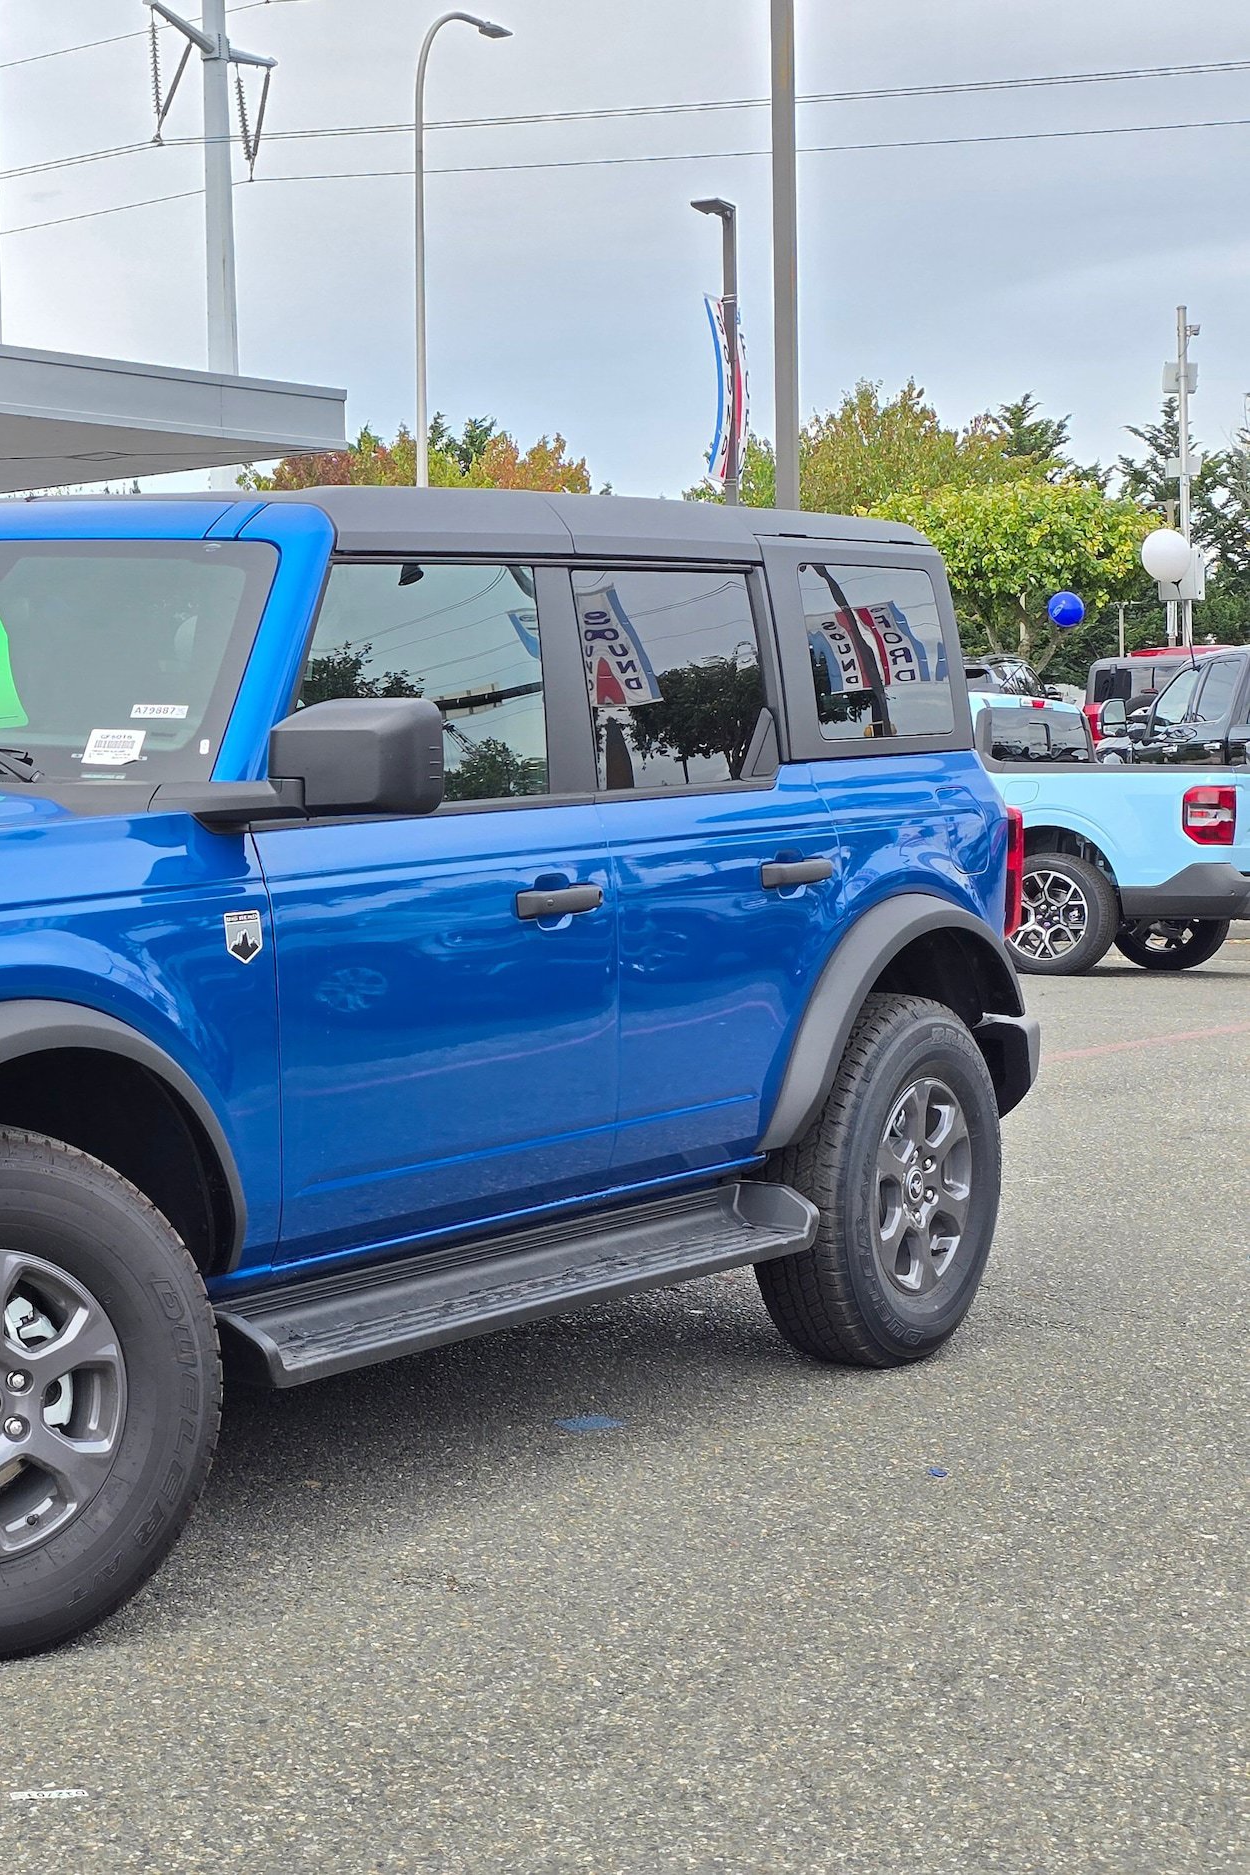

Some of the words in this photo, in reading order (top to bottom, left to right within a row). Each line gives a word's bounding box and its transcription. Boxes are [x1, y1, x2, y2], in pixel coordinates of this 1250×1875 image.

[715, 314, 733, 456] SOUND
[134, 705, 176, 715] A79887
[133, 1277, 200, 1546] DUELER
